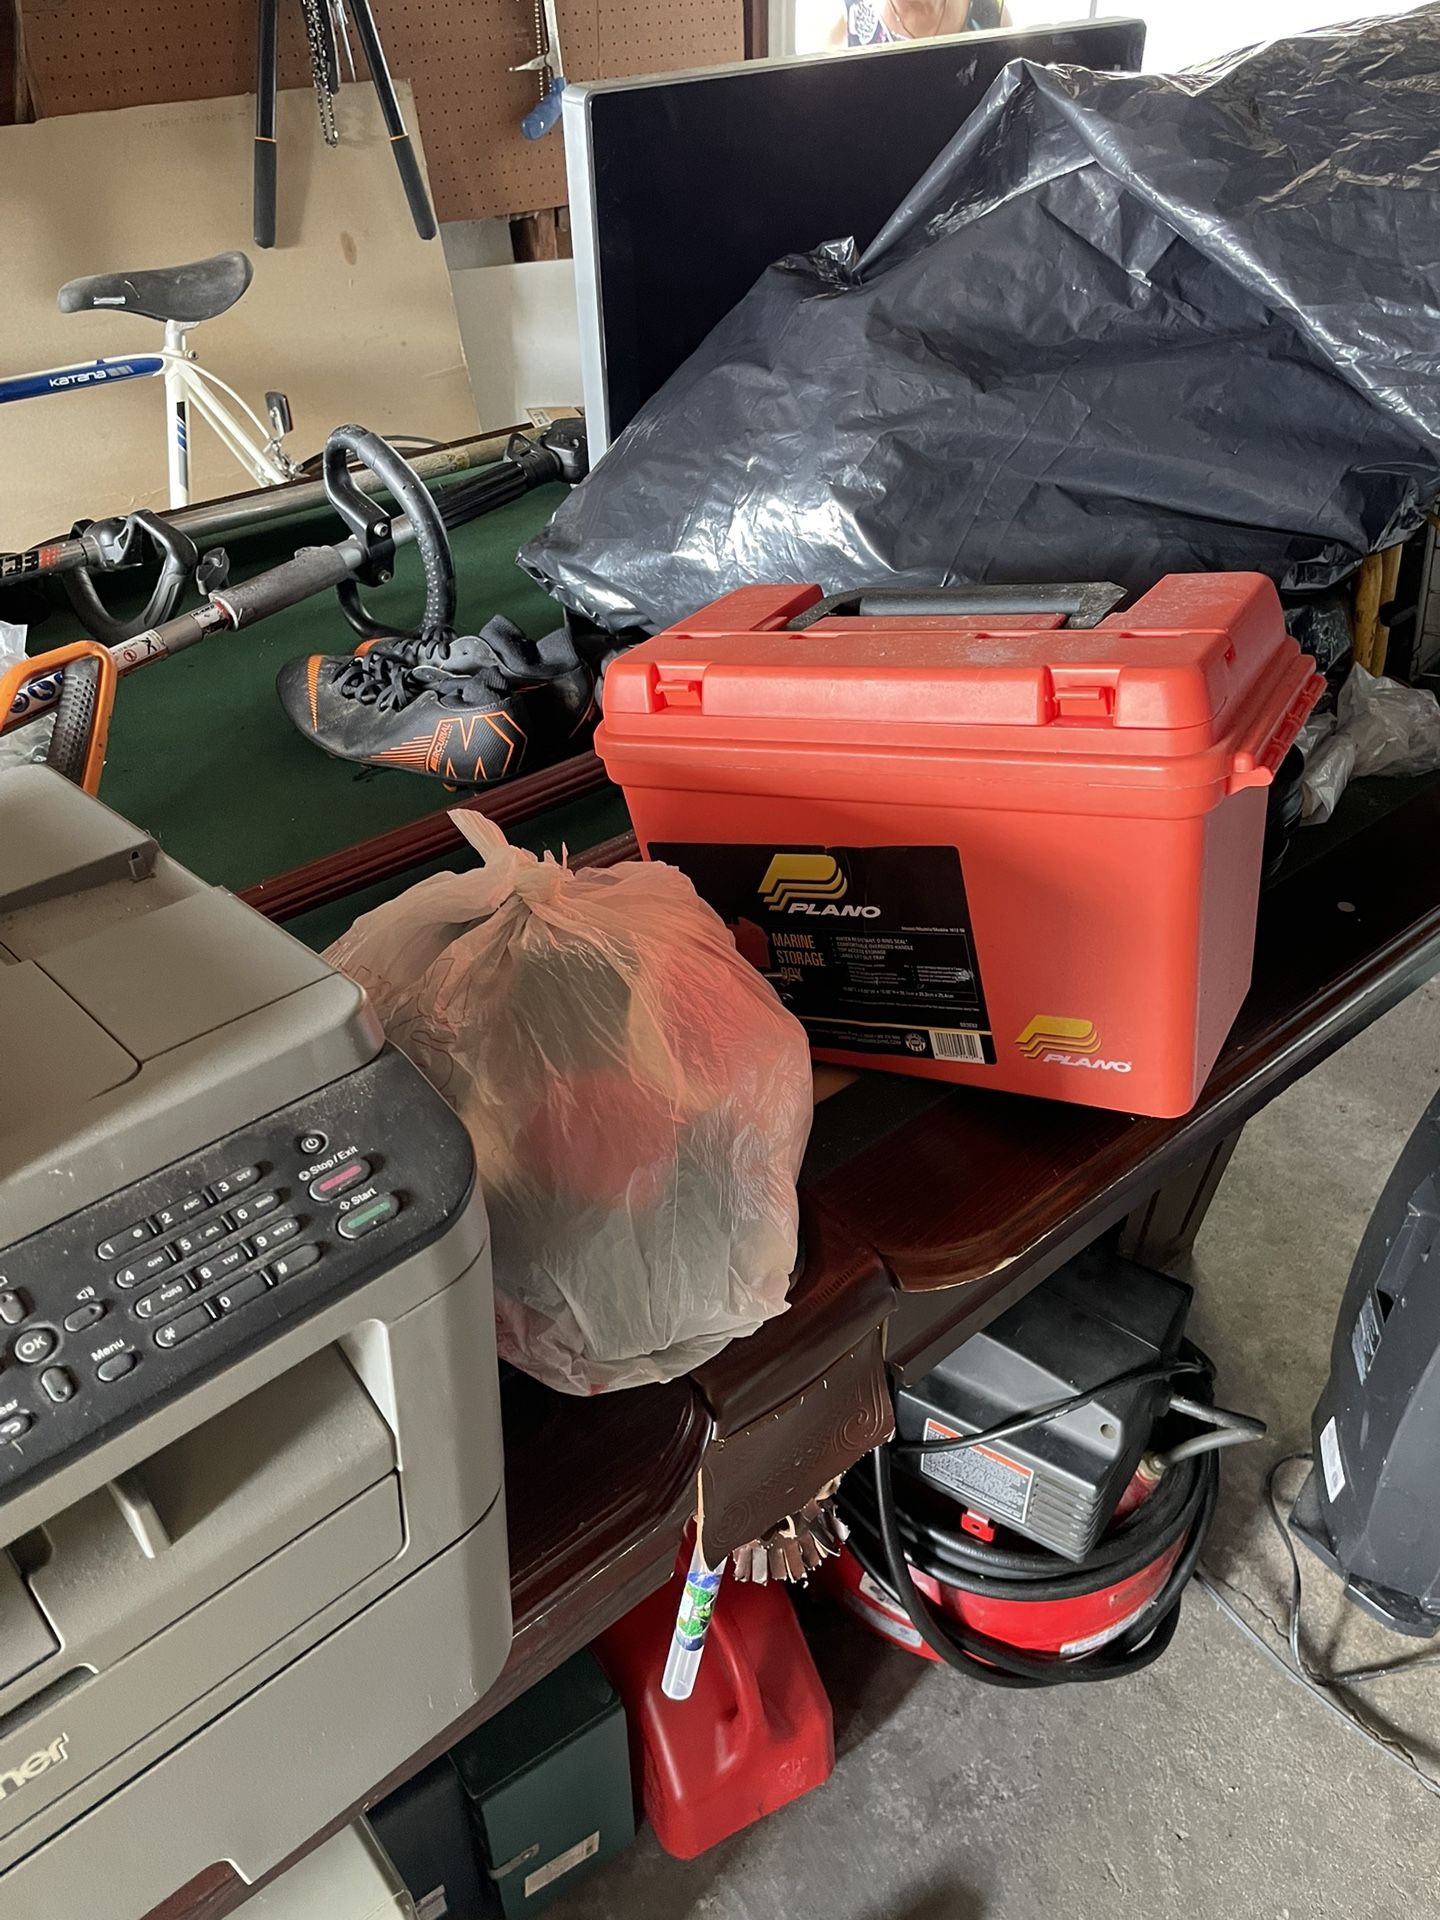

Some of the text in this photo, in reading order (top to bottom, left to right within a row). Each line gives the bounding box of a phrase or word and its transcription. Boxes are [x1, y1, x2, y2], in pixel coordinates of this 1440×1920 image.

[787, 902, 881, 918] PLANO
[771, 932, 816, 949] MARINE
[776, 950, 826, 967] STORAGE
[1043, 1053, 1132, 1073] PLANO
[218, 1181, 230, 1192] 3
[350, 1187, 378, 1205] Start
[161, 1198, 200, 1224] 2 ABC
[237, 1208, 248, 1219] 6
[104, 1243, 115, 1253] 1
[180, 1238, 192, 1250] 5
[256, 1236, 267, 1247] 9
[200, 1252, 239, 1279] 8 TUV
[125, 1270, 135, 1281] 4
[141, 1299, 151, 1312] 7
[219, 1296, 231, 1308] 0
[22, 1335, 48, 1355] OK
[90, 1338, 125, 1362] Menu
